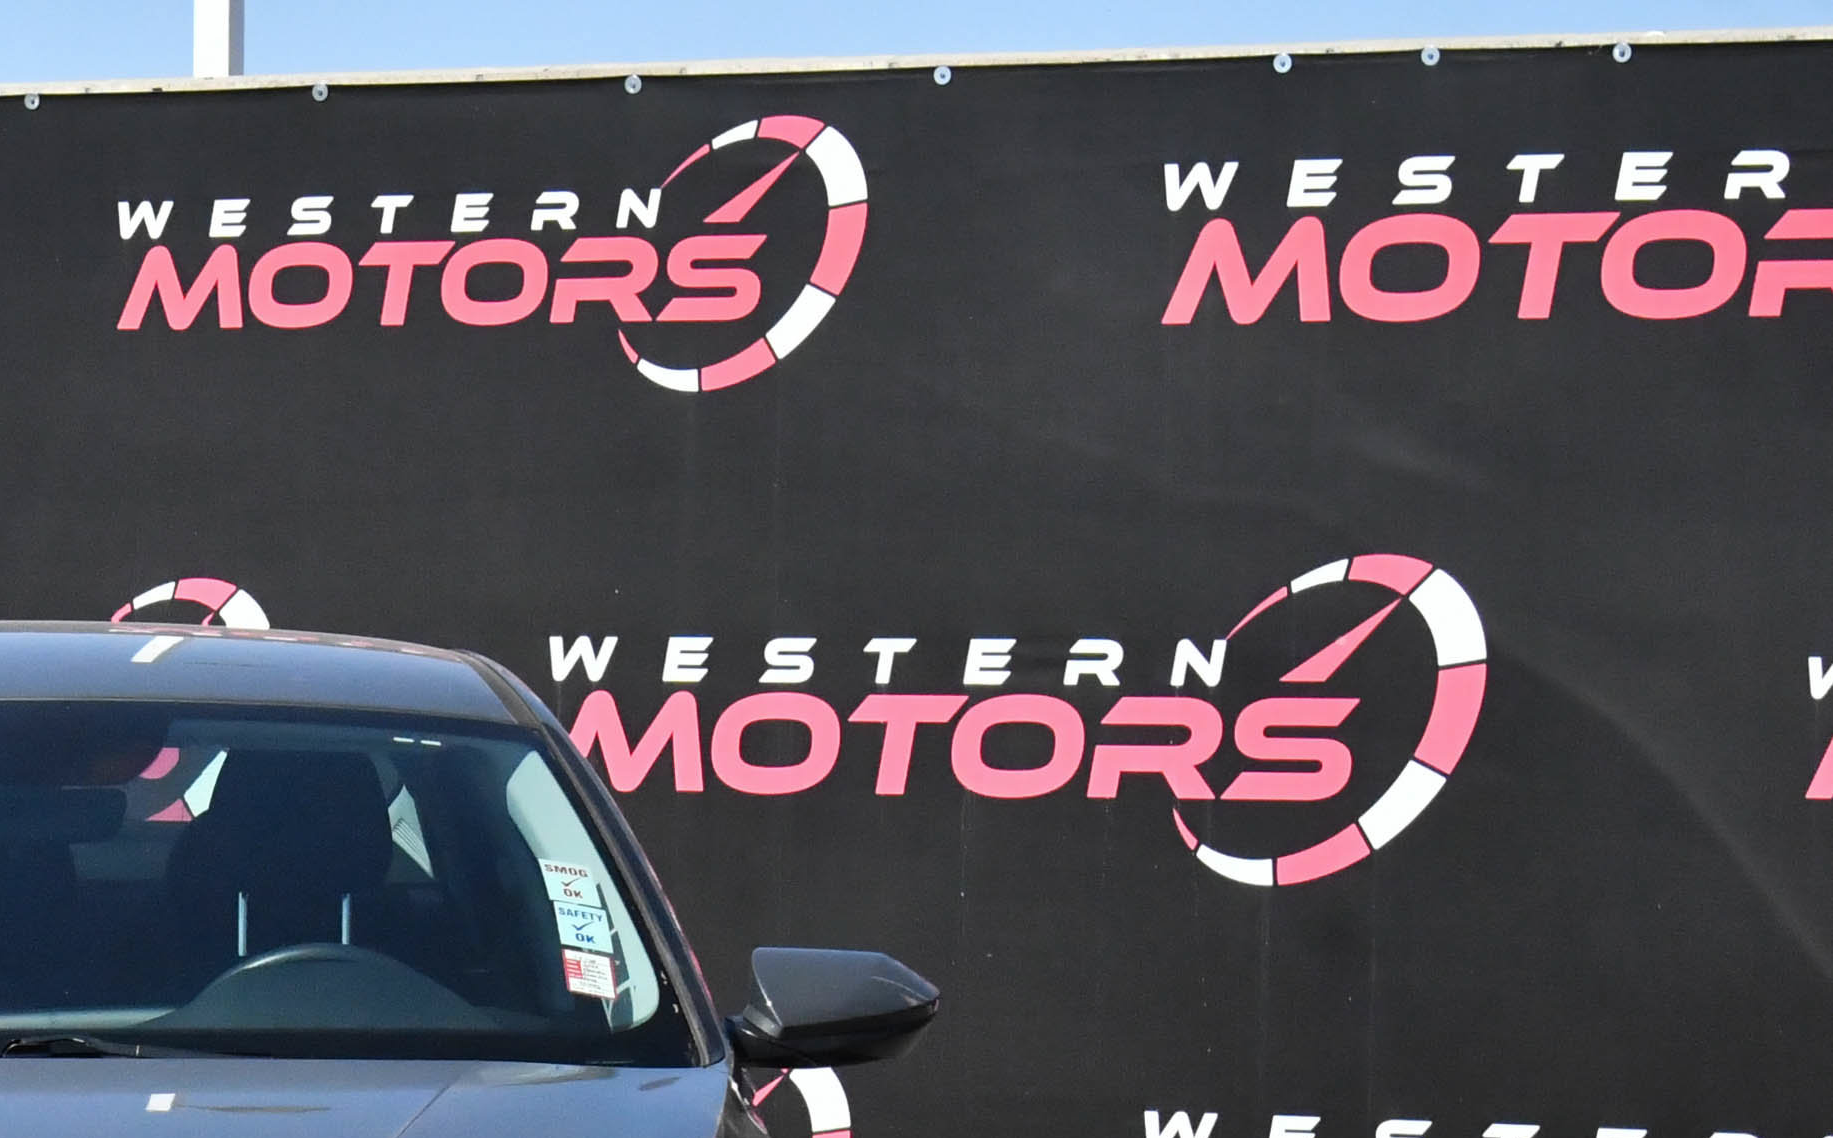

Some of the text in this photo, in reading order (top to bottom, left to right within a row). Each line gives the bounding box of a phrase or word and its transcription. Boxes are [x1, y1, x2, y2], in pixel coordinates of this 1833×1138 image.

[117, 187, 663, 241] WESTERN
[117, 234, 768, 331] MOTORS
[548, 635, 1228, 689] WESTERN
[568, 689, 1361, 802] MOTORS
[544, 864, 589, 878] SMOG
[563, 888, 583, 899] OK
[558, 907, 603, 922] SAFETY
[575, 933, 595, 944] OK
